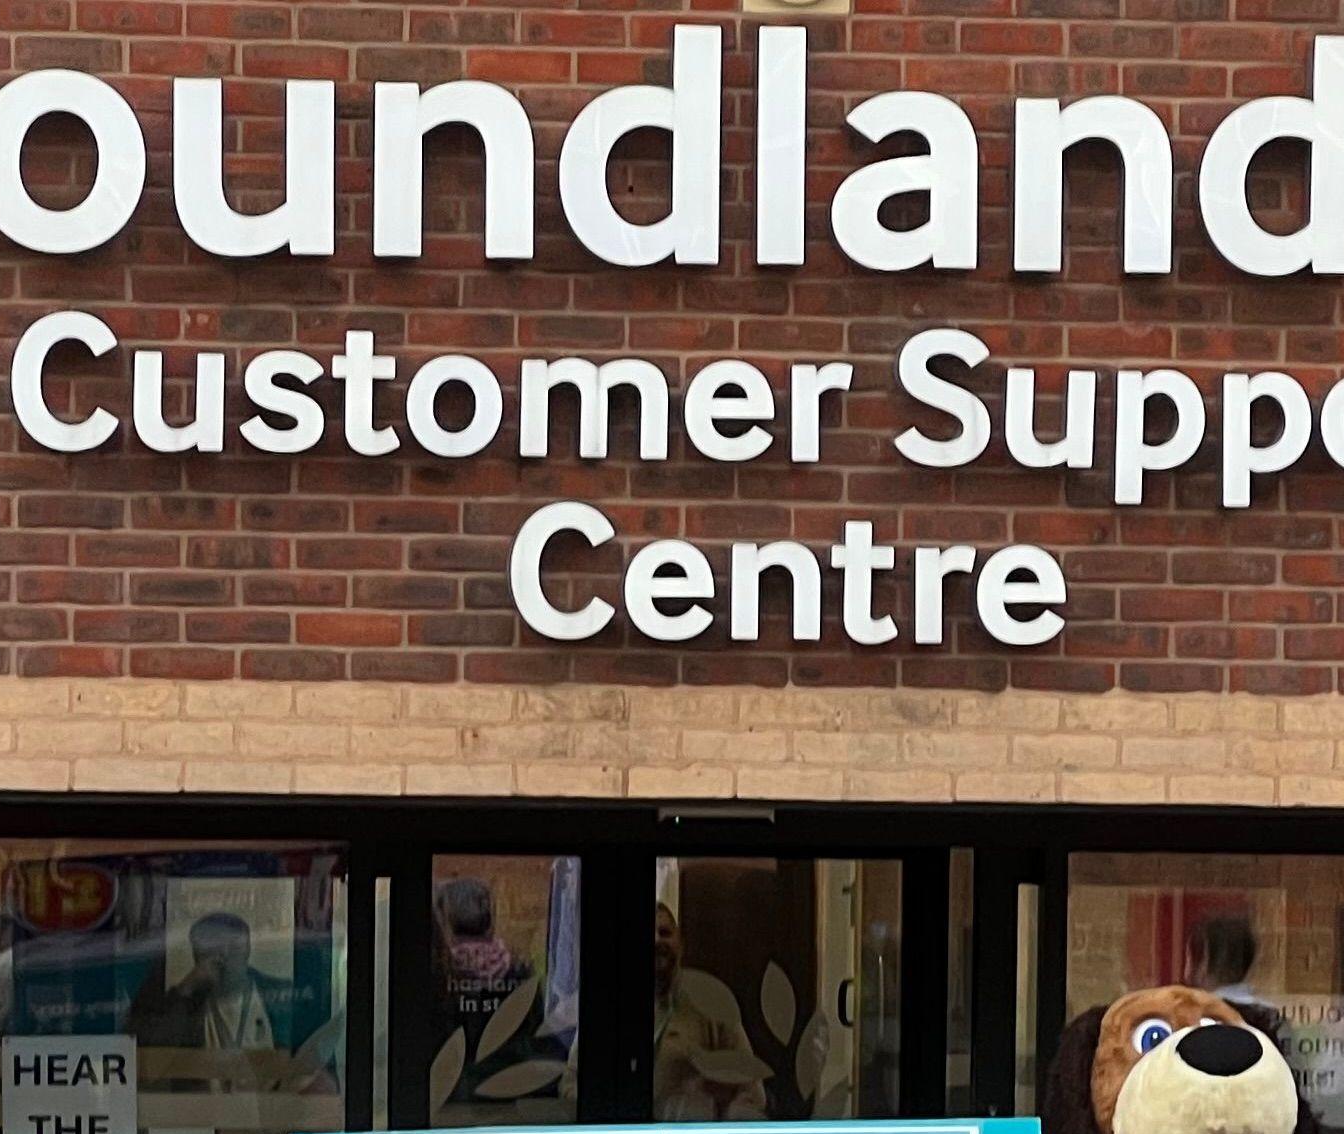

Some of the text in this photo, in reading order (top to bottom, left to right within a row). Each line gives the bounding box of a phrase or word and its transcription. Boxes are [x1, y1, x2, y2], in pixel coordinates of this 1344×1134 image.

[11, 311, 854, 463] Customer
[509, 501, 1068, 646] Centre
[13, 1054, 127, 1088] HEAR
